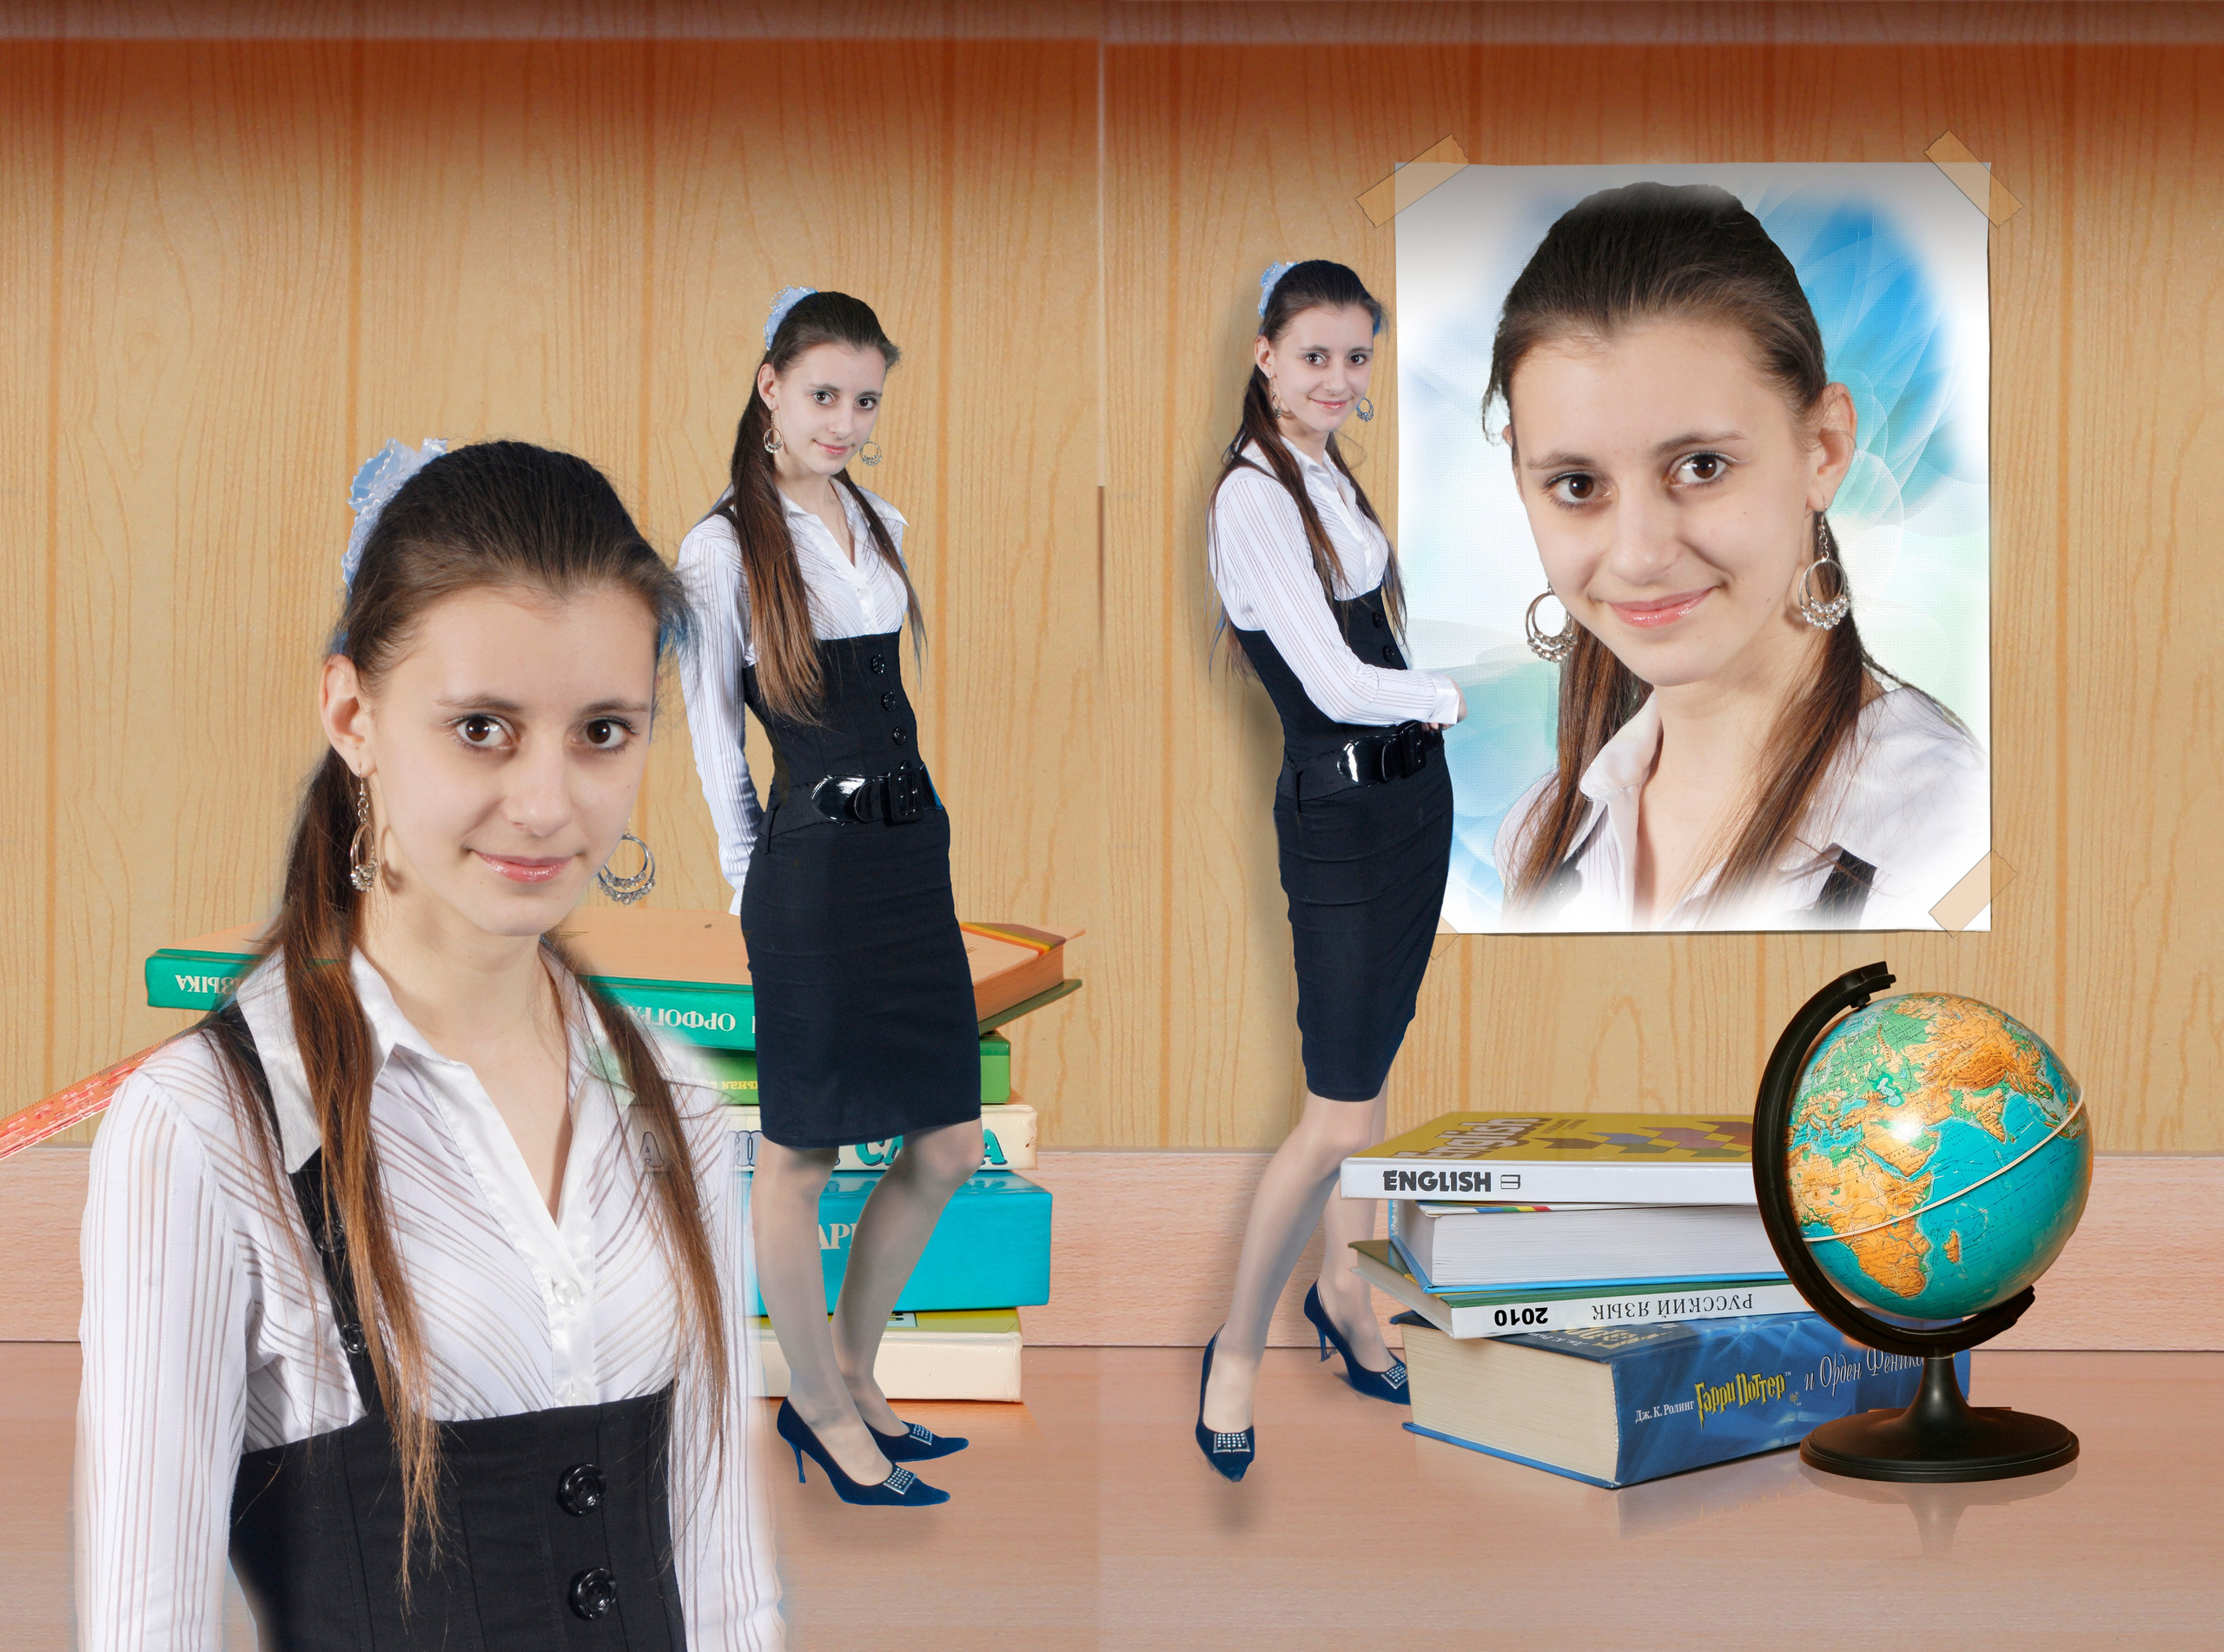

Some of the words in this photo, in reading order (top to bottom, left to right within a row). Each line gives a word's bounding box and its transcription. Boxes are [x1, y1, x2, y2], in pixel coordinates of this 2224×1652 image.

[1382, 1170, 1492, 1193] ENGLISH
[1494, 1306, 1549, 1326] 2010
[1591, 1300, 1651, 1320] ЯЗЫК
[1657, 1293, 1753, 1318] РУССКИЙ
[1635, 1409, 1652, 1424] Дж.
[1653, 1405, 1663, 1418] К.
[1663, 1400, 1695, 1416] Ролинг
[1694, 1381, 1737, 1431] Гарри
[1735, 1372, 1786, 1409] Поттер
[1804, 1371, 1816, 1391] и
[1819, 1352, 1863, 1397] Орден
